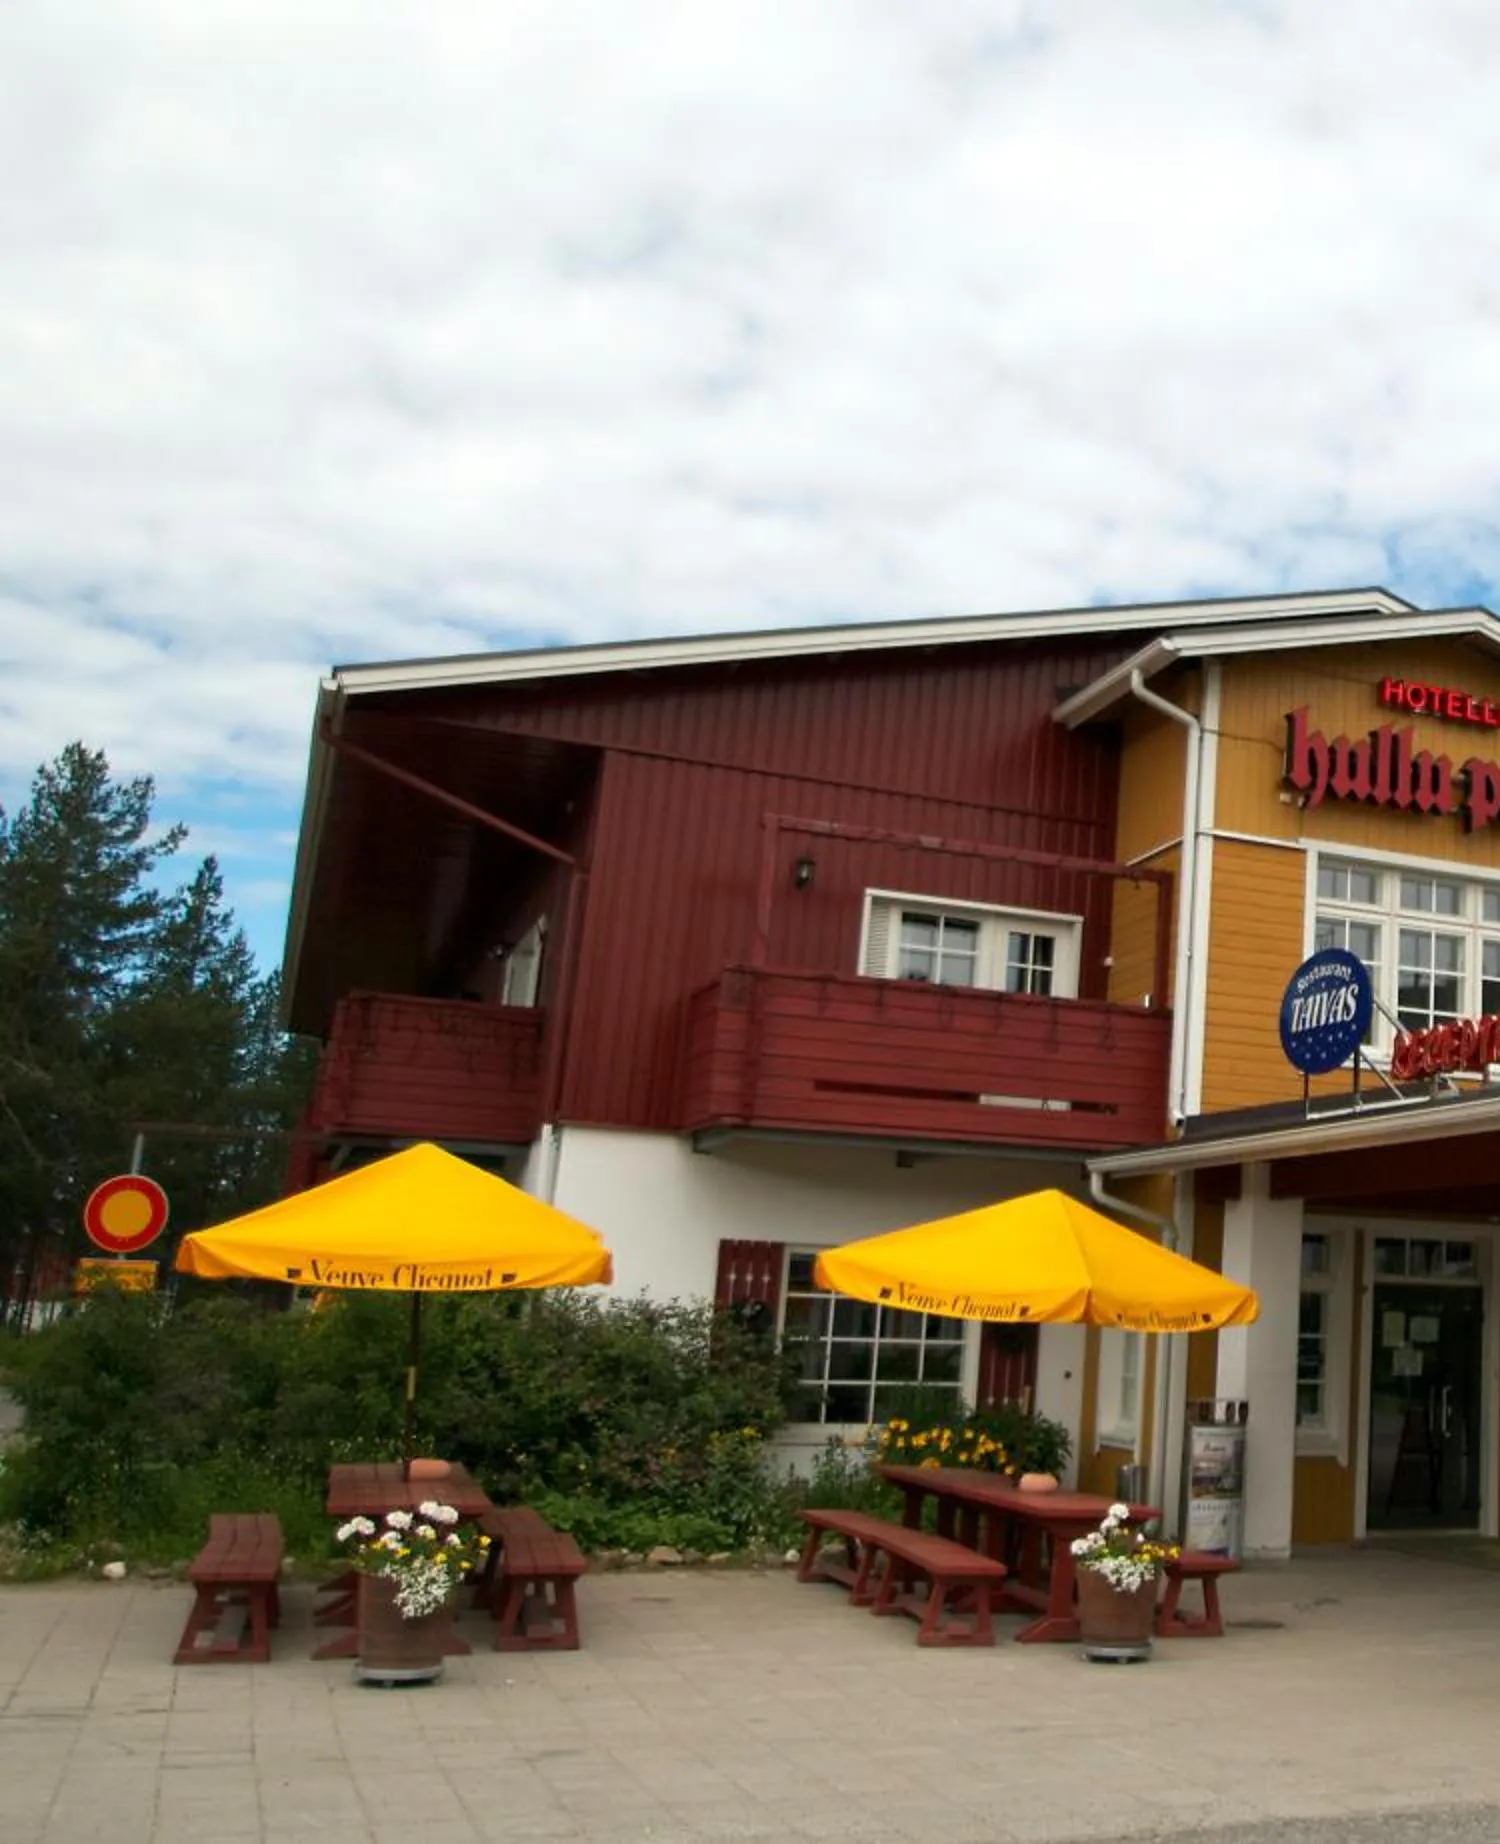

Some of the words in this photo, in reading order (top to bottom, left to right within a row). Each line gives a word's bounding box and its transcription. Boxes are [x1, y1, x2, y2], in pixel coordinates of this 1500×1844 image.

[1287, 705, 1453, 814] hullu
[1291, 983, 1359, 1034] TAIVAS
[310, 1258, 384, 1288] Veuve
[391, 1263, 493, 1290] Clicquot
